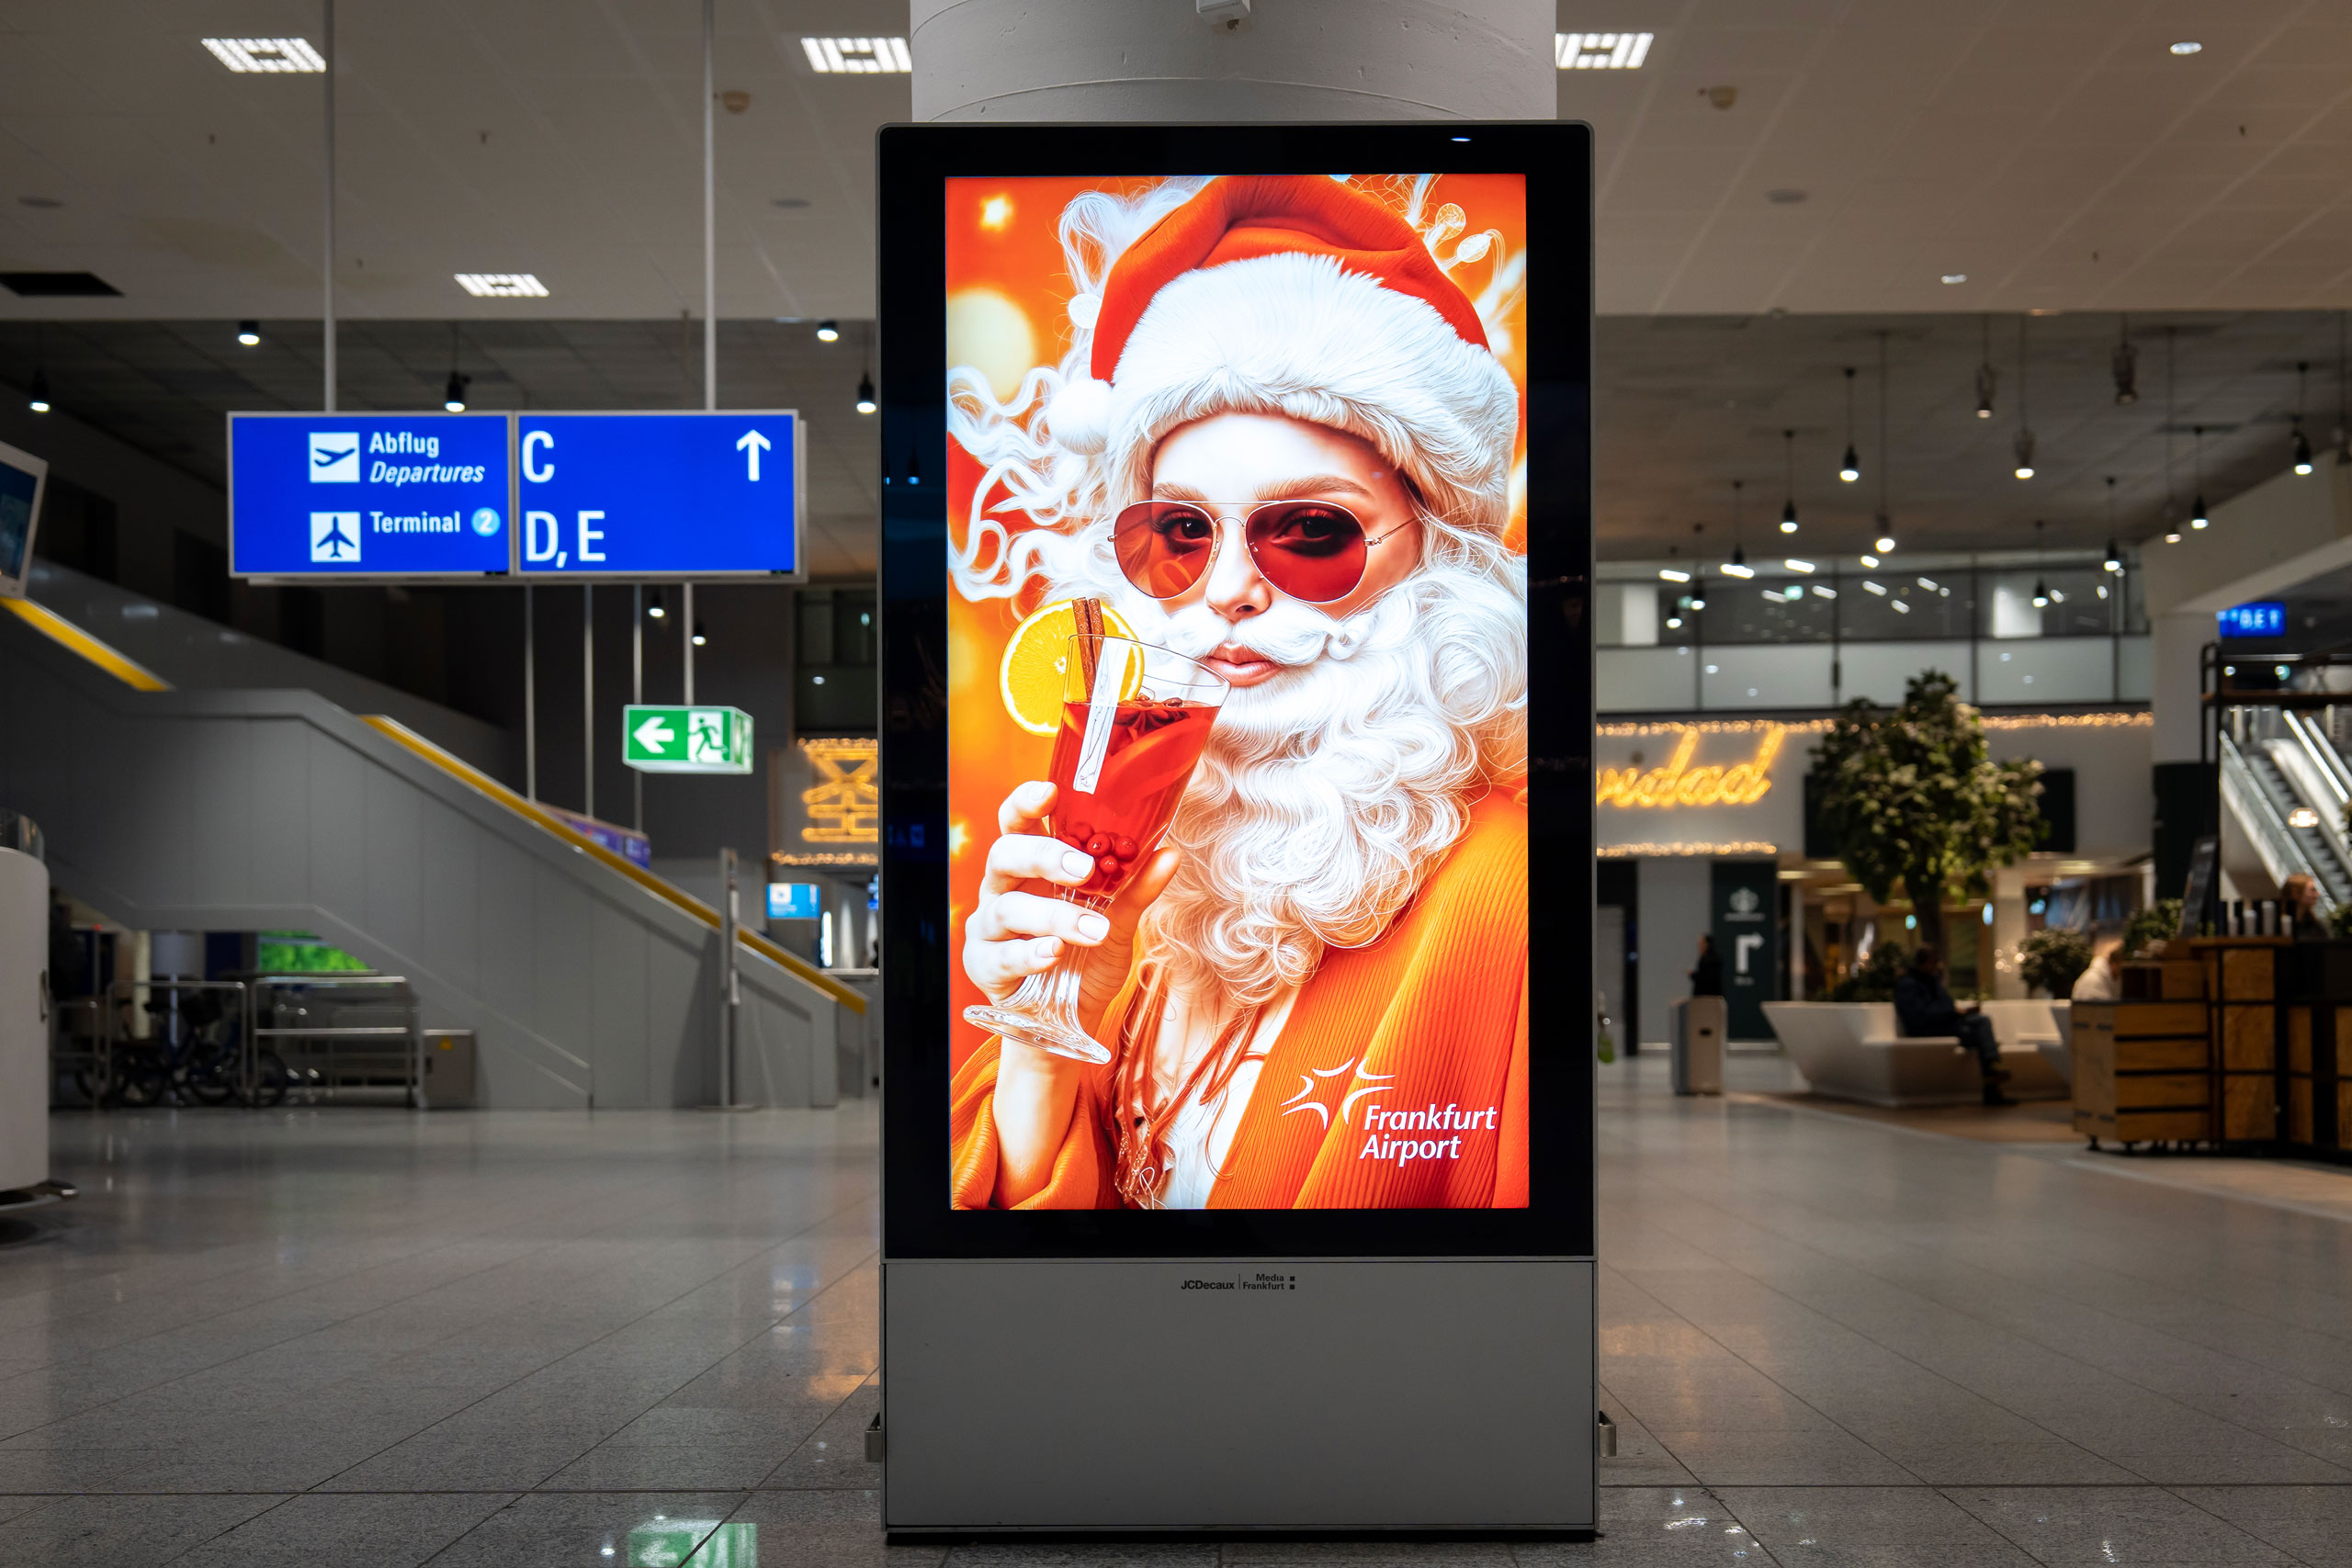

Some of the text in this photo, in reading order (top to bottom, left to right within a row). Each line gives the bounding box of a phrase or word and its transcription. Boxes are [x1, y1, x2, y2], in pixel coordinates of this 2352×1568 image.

[369, 432, 439, 458] Abflug
[522, 430, 555, 483] C
[369, 460, 485, 487] Departures
[369, 511, 492, 533] Terminal 2
[1364, 1104, 1498, 1130] Frankfurt
[1360, 1134, 1462, 1167] Airport
[1181, 1280, 1235, 1290] JCDecaux
[1243, 1281, 1284, 1290] Frankfurt
[1256, 1273, 1284, 1281] Media
